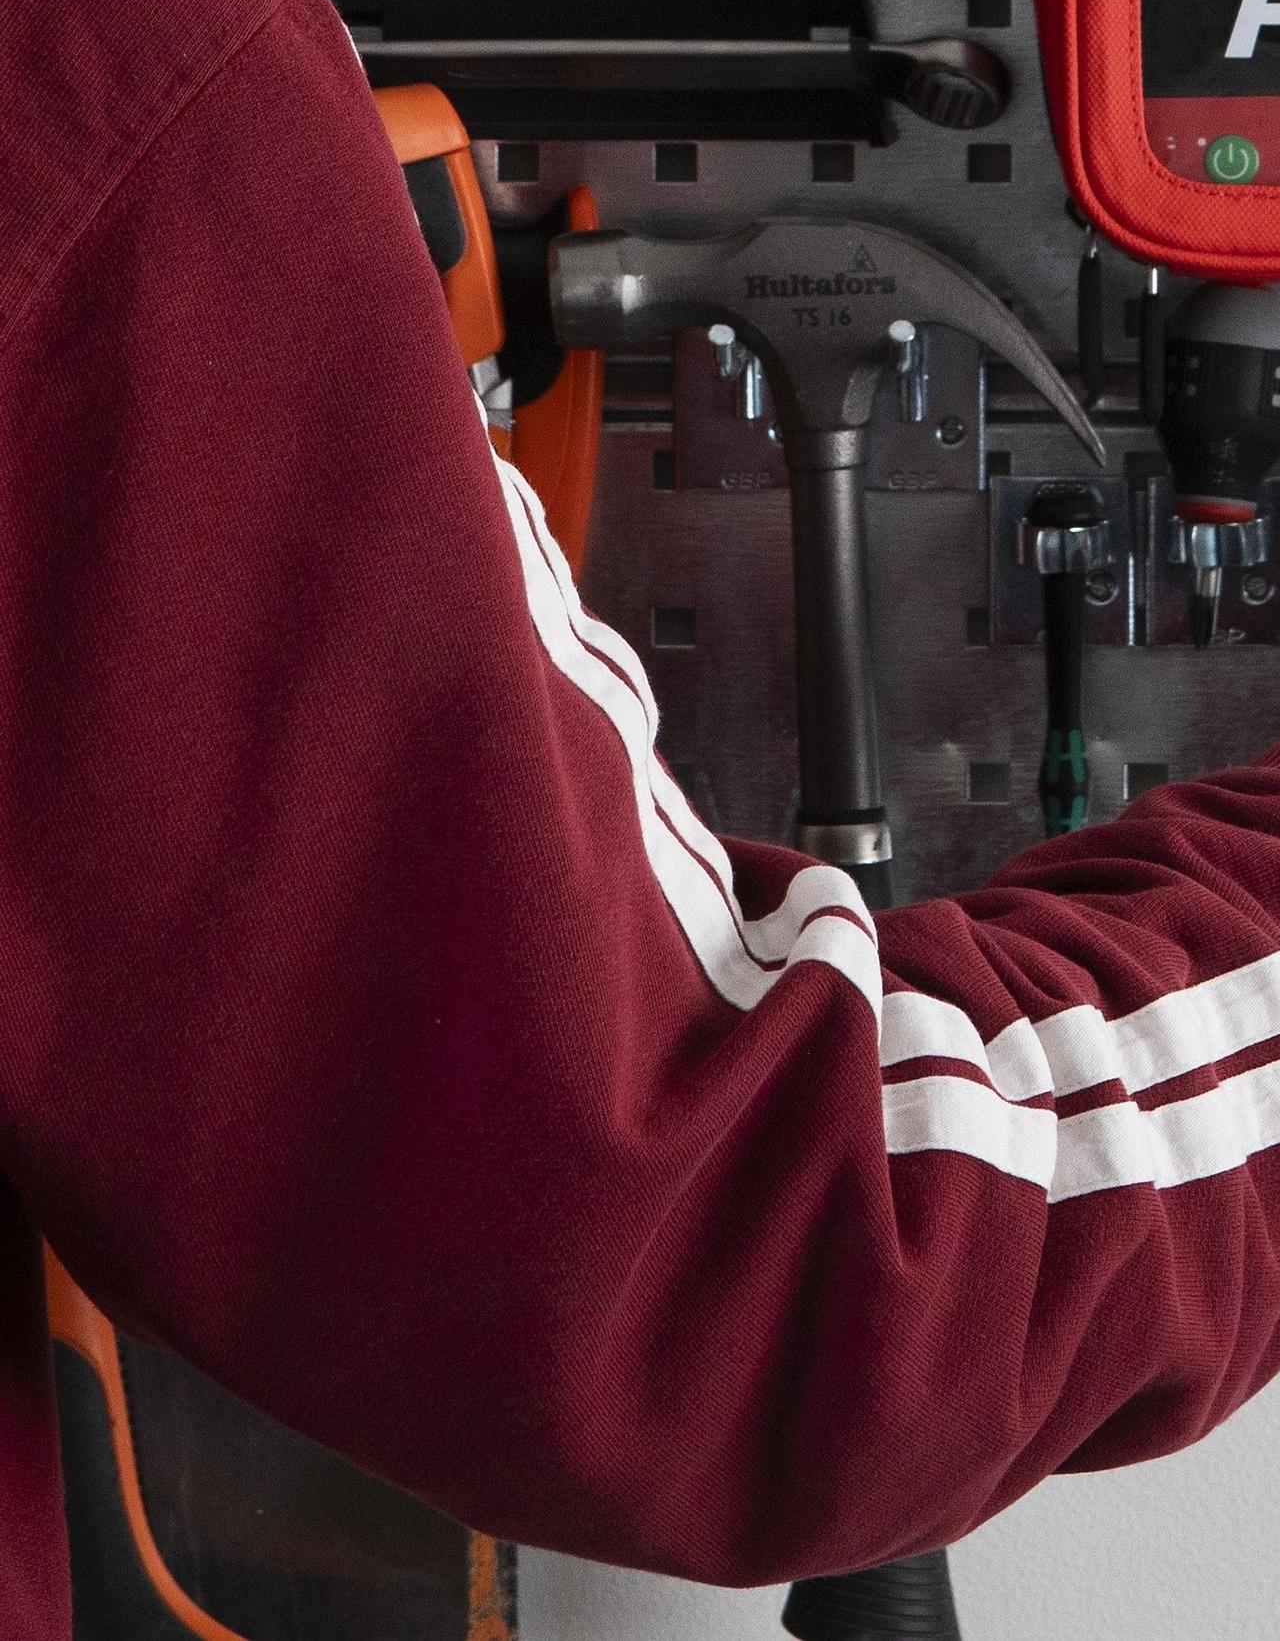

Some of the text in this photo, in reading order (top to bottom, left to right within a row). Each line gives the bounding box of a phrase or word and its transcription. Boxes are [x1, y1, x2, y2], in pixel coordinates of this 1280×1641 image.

[745, 273, 896, 299] Hultafors
[792, 307, 852, 326] TS 16
